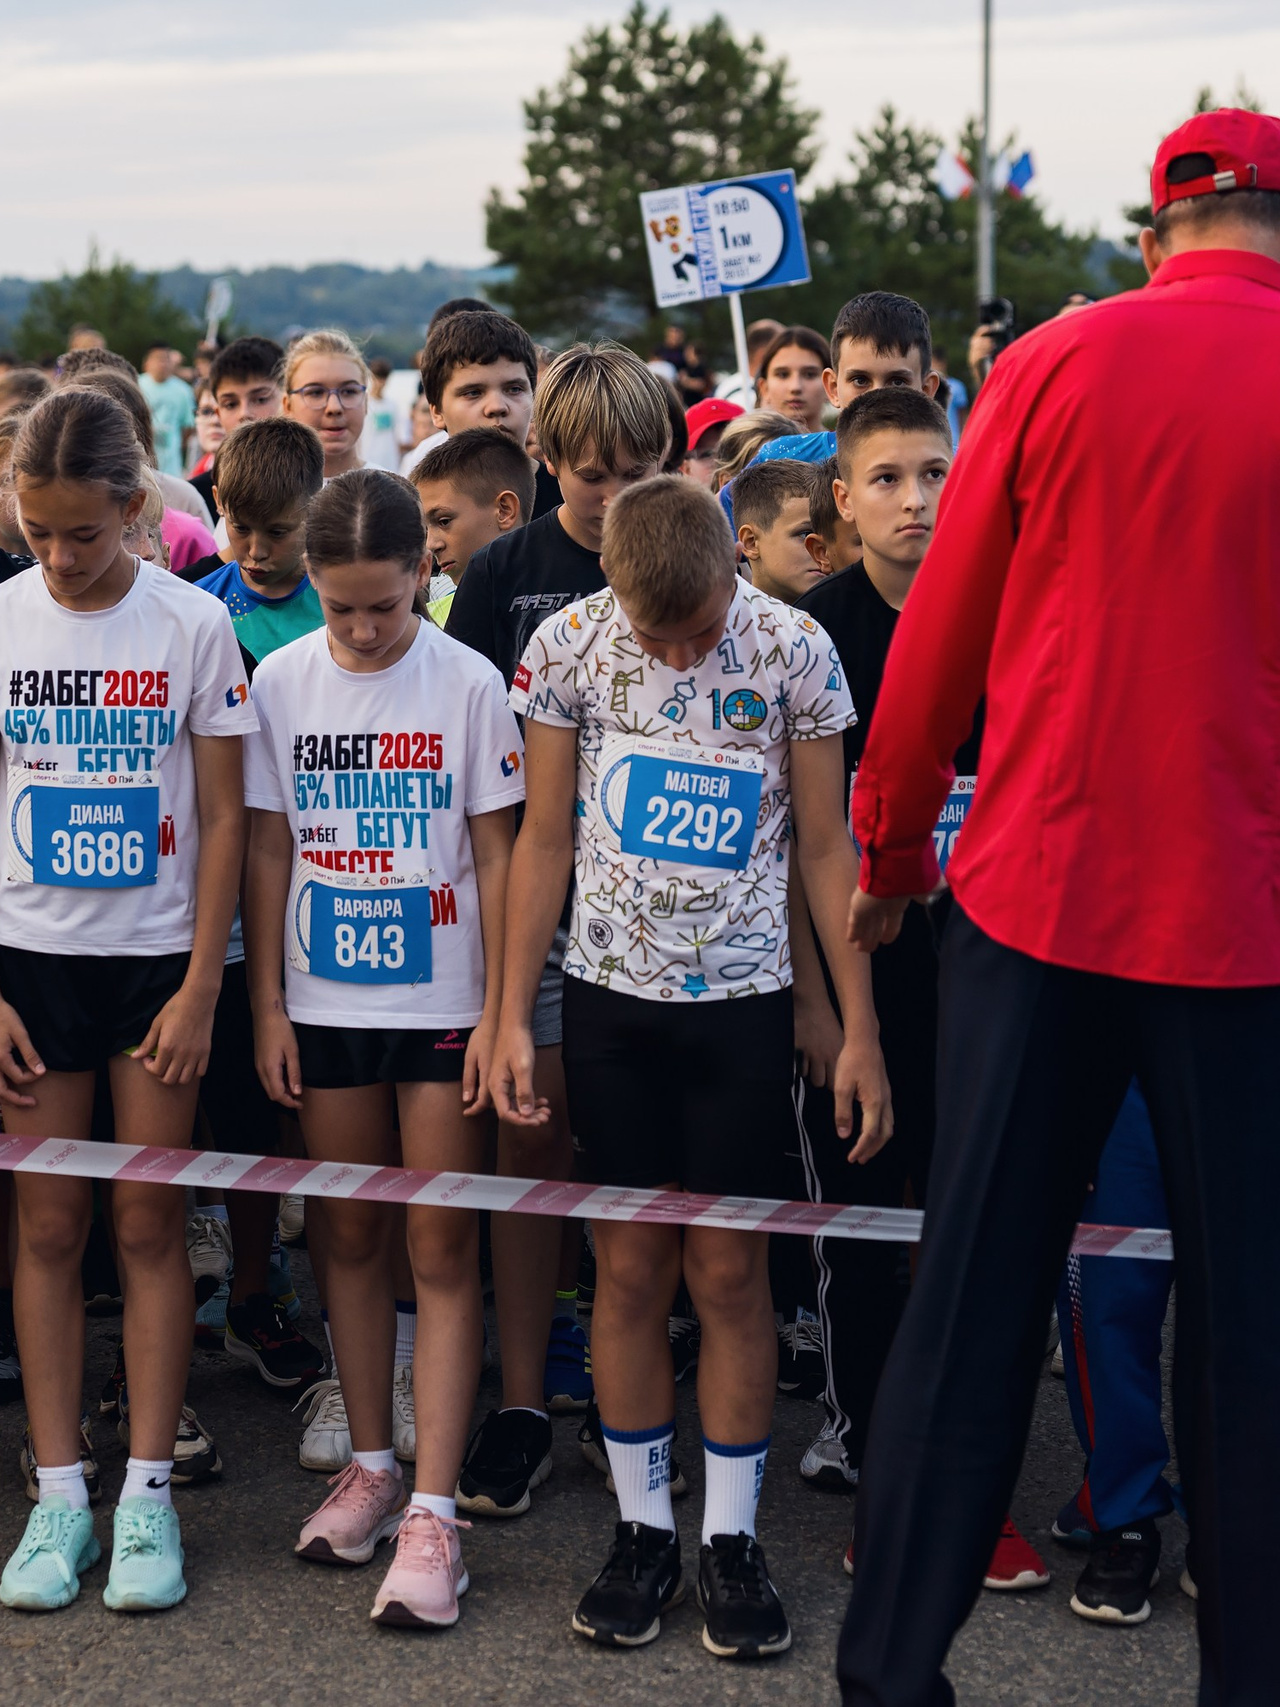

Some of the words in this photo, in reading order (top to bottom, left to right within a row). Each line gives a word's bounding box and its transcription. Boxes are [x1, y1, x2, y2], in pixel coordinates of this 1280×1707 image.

[719, 225, 729, 250] 1
[509, 593, 570, 612] FIRST
[10, 670, 169, 708] #ЗАБЕГ2025
[5, 709, 50, 745] 45%
[56, 709, 176, 746] ПЛАНЕТЫ
[78, 748, 156, 773] БЕГУТ
[293, 732, 443, 771] #ЗАБЕГ2025
[725, 755, 740, 765] Пэй
[119, 774, 134, 784] Пэй
[293, 773, 330, 811] 5%
[334, 772, 452, 810] ПЛАНЕТЫ
[664, 770, 731, 799] МАТВЕЙ
[967, 781, 976, 789] Пэ
[68, 804, 124, 826] ДИАНА
[642, 796, 743, 855] 2292
[938, 804, 964, 823] ВАН
[299, 826, 338, 844] ЗАБЕГ
[356, 812, 431, 849] БЕГУТ
[51, 830, 144, 877] 3686
[390, 876, 406, 885] Пэй
[333, 897, 403, 919] ВАРВАРА
[334, 924, 405, 969] 843
